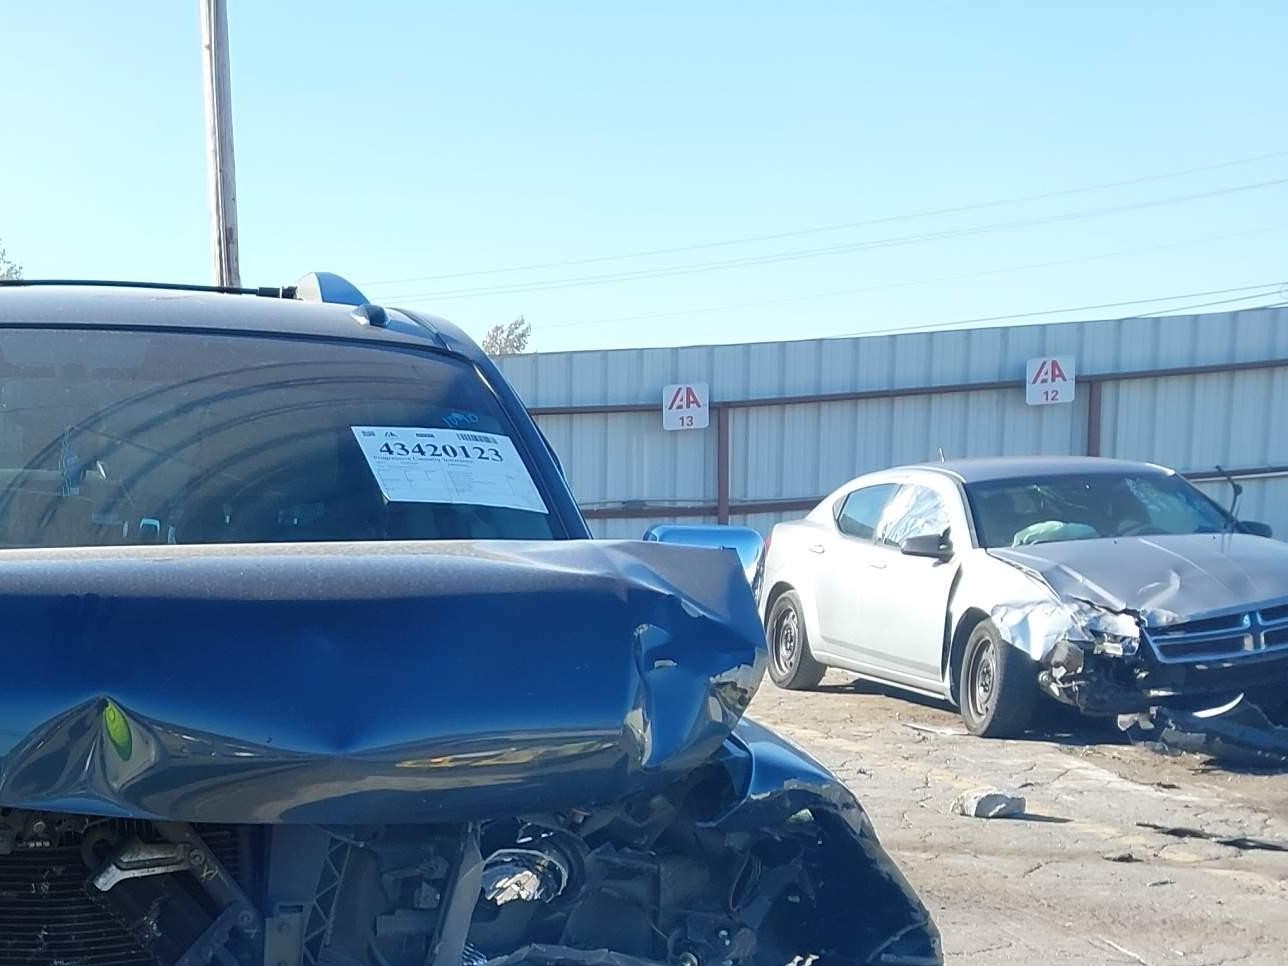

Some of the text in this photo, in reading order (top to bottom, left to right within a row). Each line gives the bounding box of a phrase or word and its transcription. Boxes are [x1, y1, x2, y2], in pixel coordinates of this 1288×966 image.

[1043, 389, 1059, 401] 12
[679, 414, 694, 427] 13
[379, 441, 504, 463] 43420123
